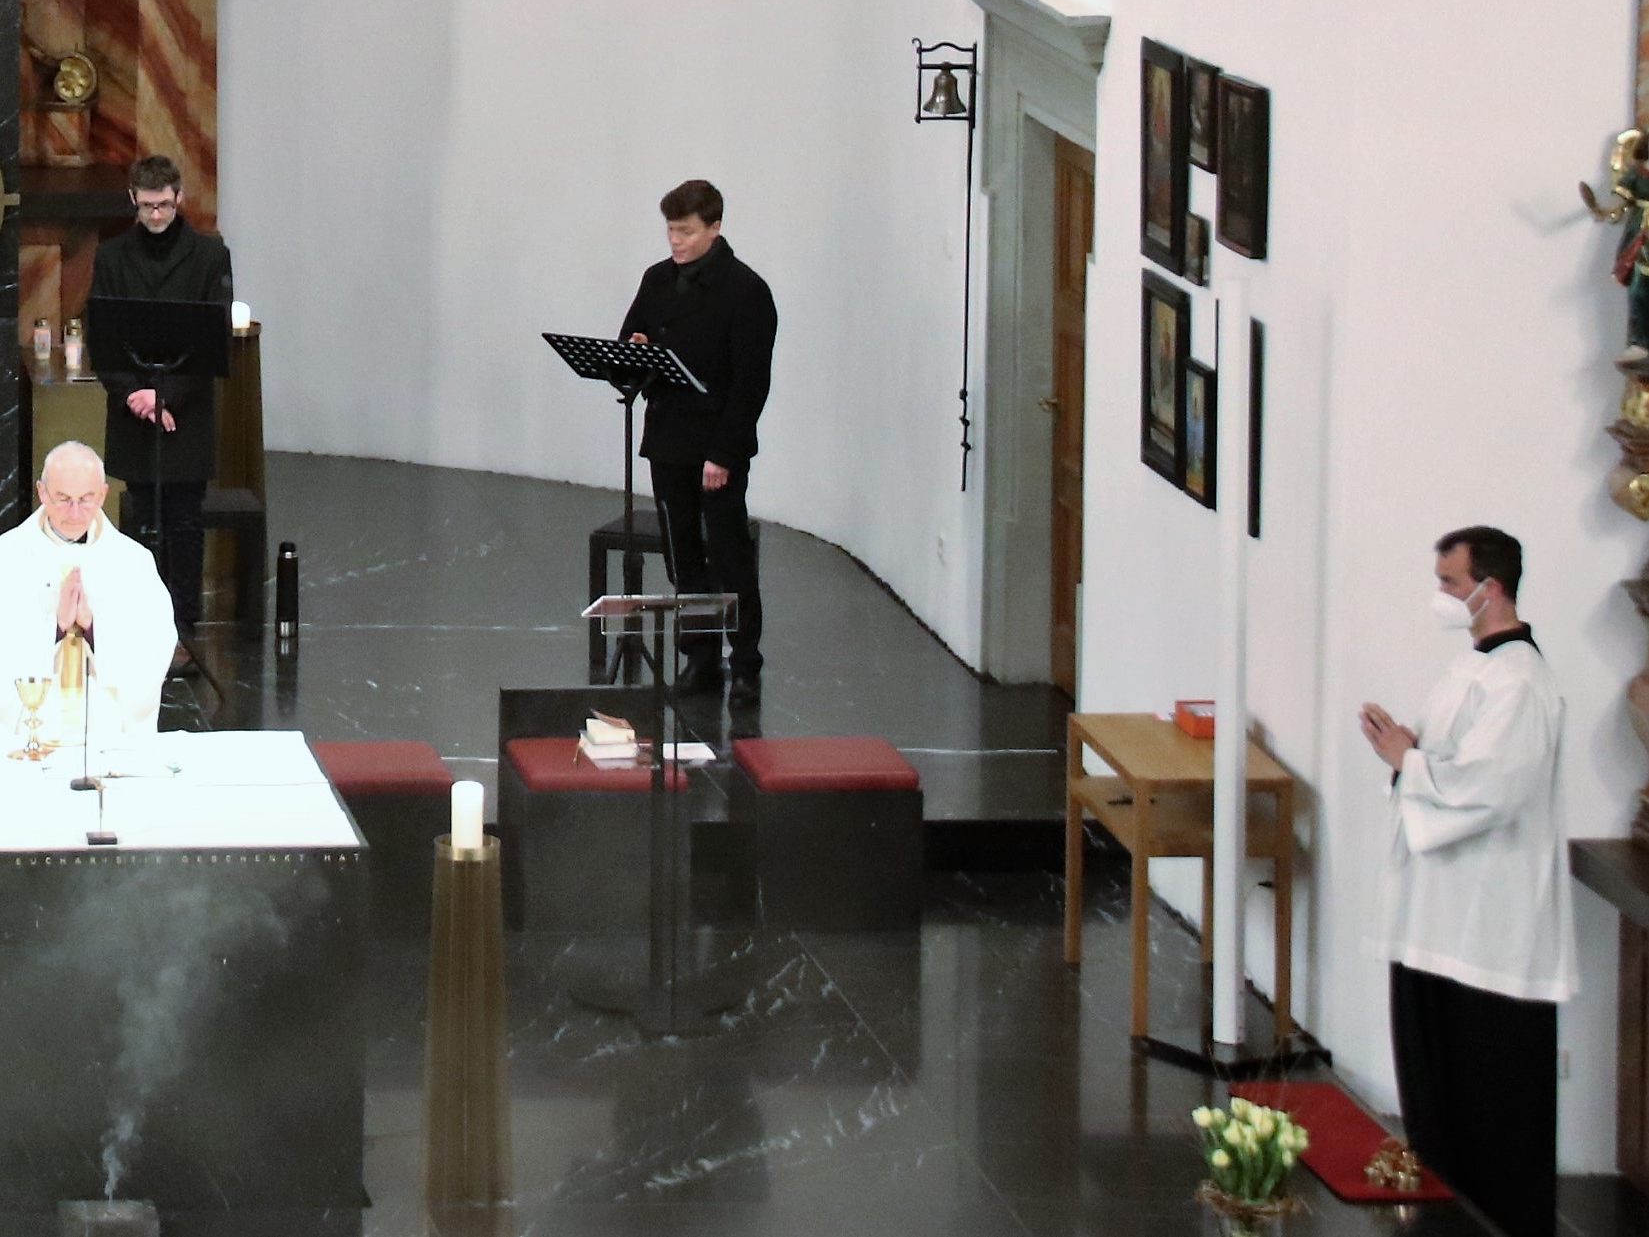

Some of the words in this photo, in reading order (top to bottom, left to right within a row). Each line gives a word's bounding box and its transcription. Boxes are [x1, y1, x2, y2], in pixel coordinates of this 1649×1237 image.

[14, 855, 163, 866] EUCHARISTIE
[181, 854, 305, 864] GESCHENKT
[324, 853, 360, 862] HAT
